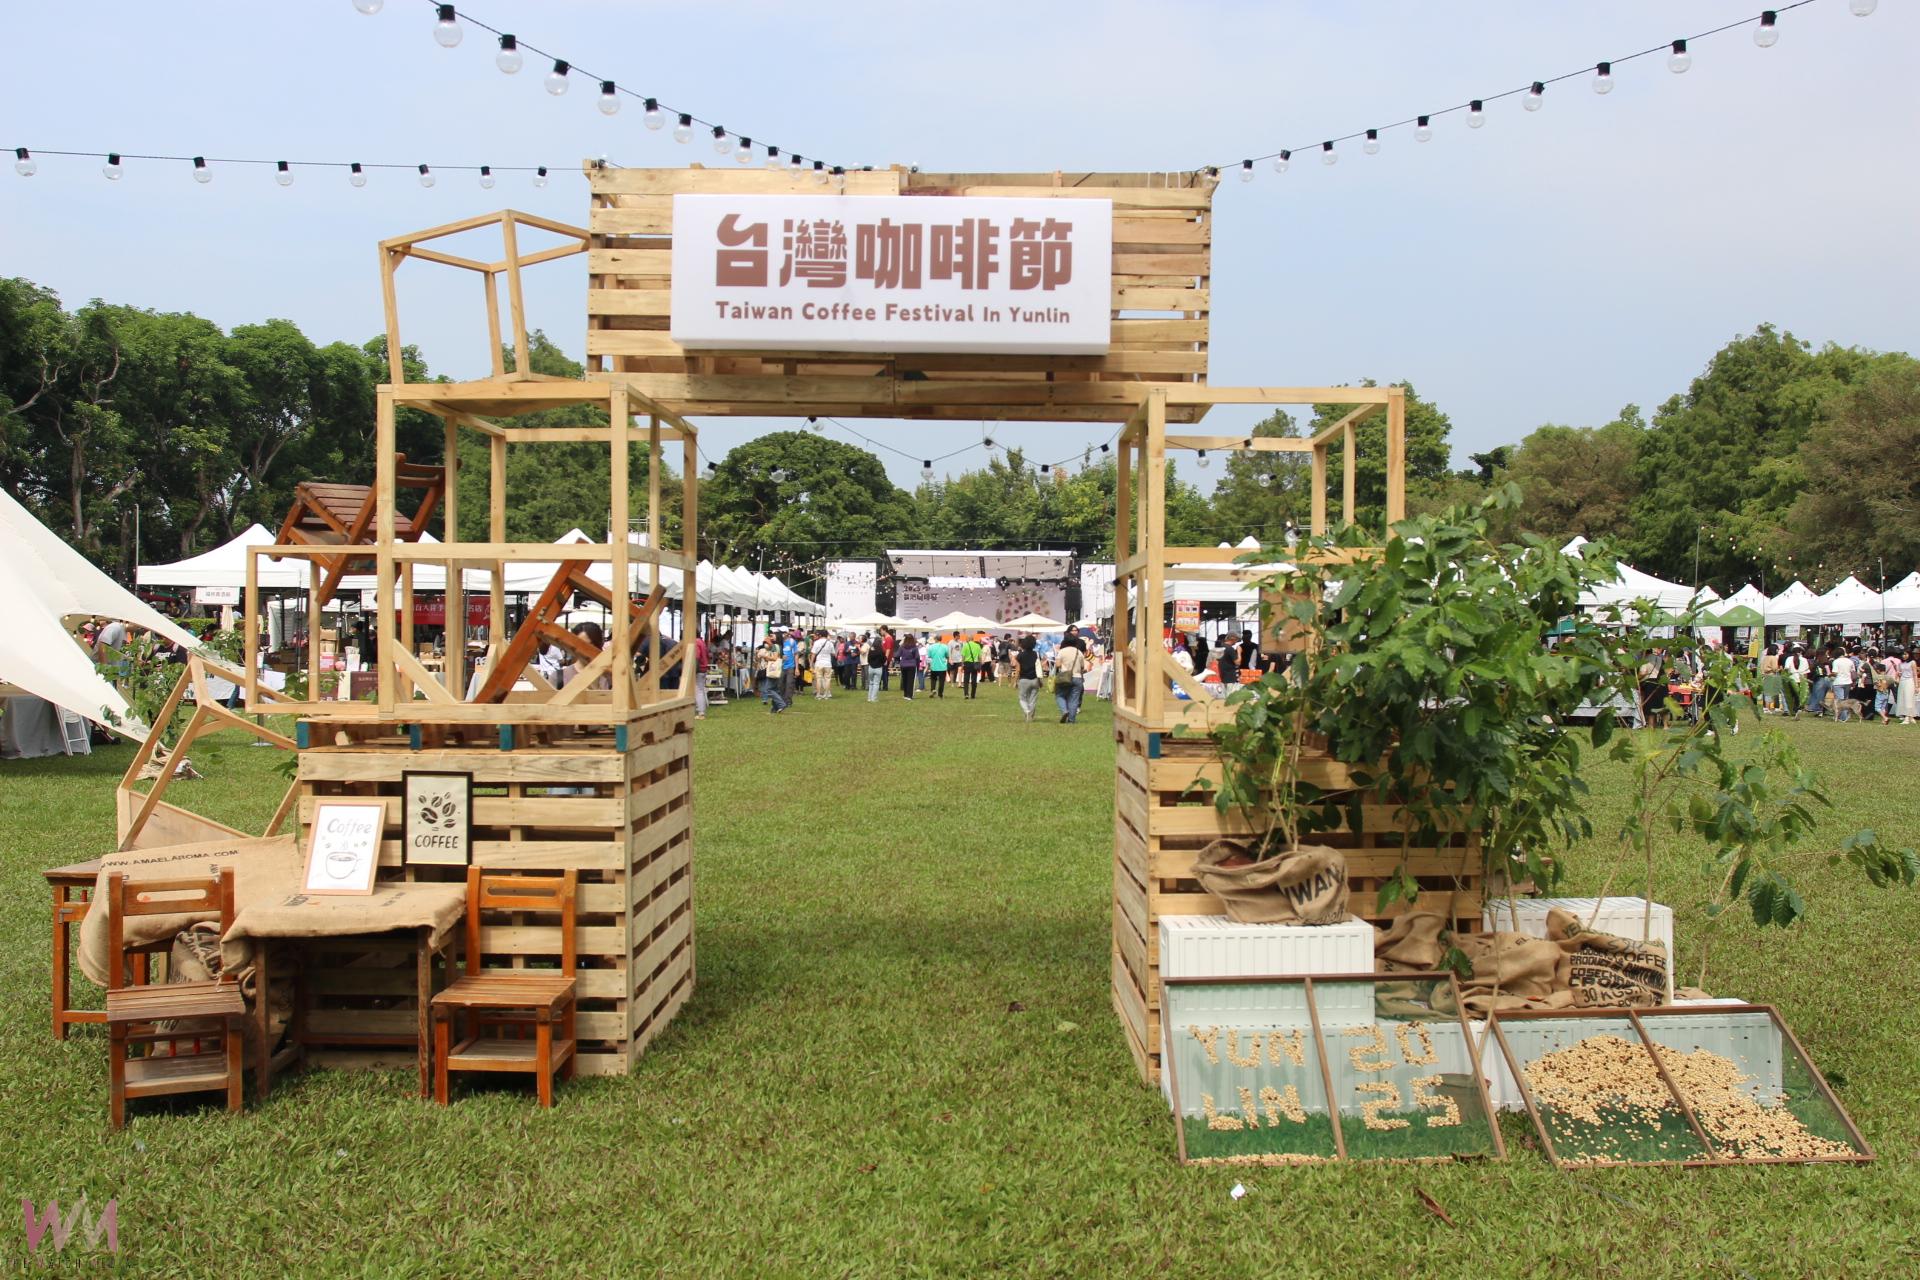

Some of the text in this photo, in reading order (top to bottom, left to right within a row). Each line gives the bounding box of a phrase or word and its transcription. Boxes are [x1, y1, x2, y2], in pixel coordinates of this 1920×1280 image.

[716, 213, 1073, 291] 台灣咖啡節
[715, 301, 1070, 323] Taiwan Coffee Festival In Yunlin
[327, 818, 372, 836] Coffee
[415, 835, 459, 849] COFFEE
[1581, 987, 1598, 1003] 30
[1188, 1024, 1305, 1068] YUN
[1344, 1020, 1440, 1072] 20
[1200, 1084, 1307, 1131] LIN
[1355, 1075, 1461, 1131] 25
